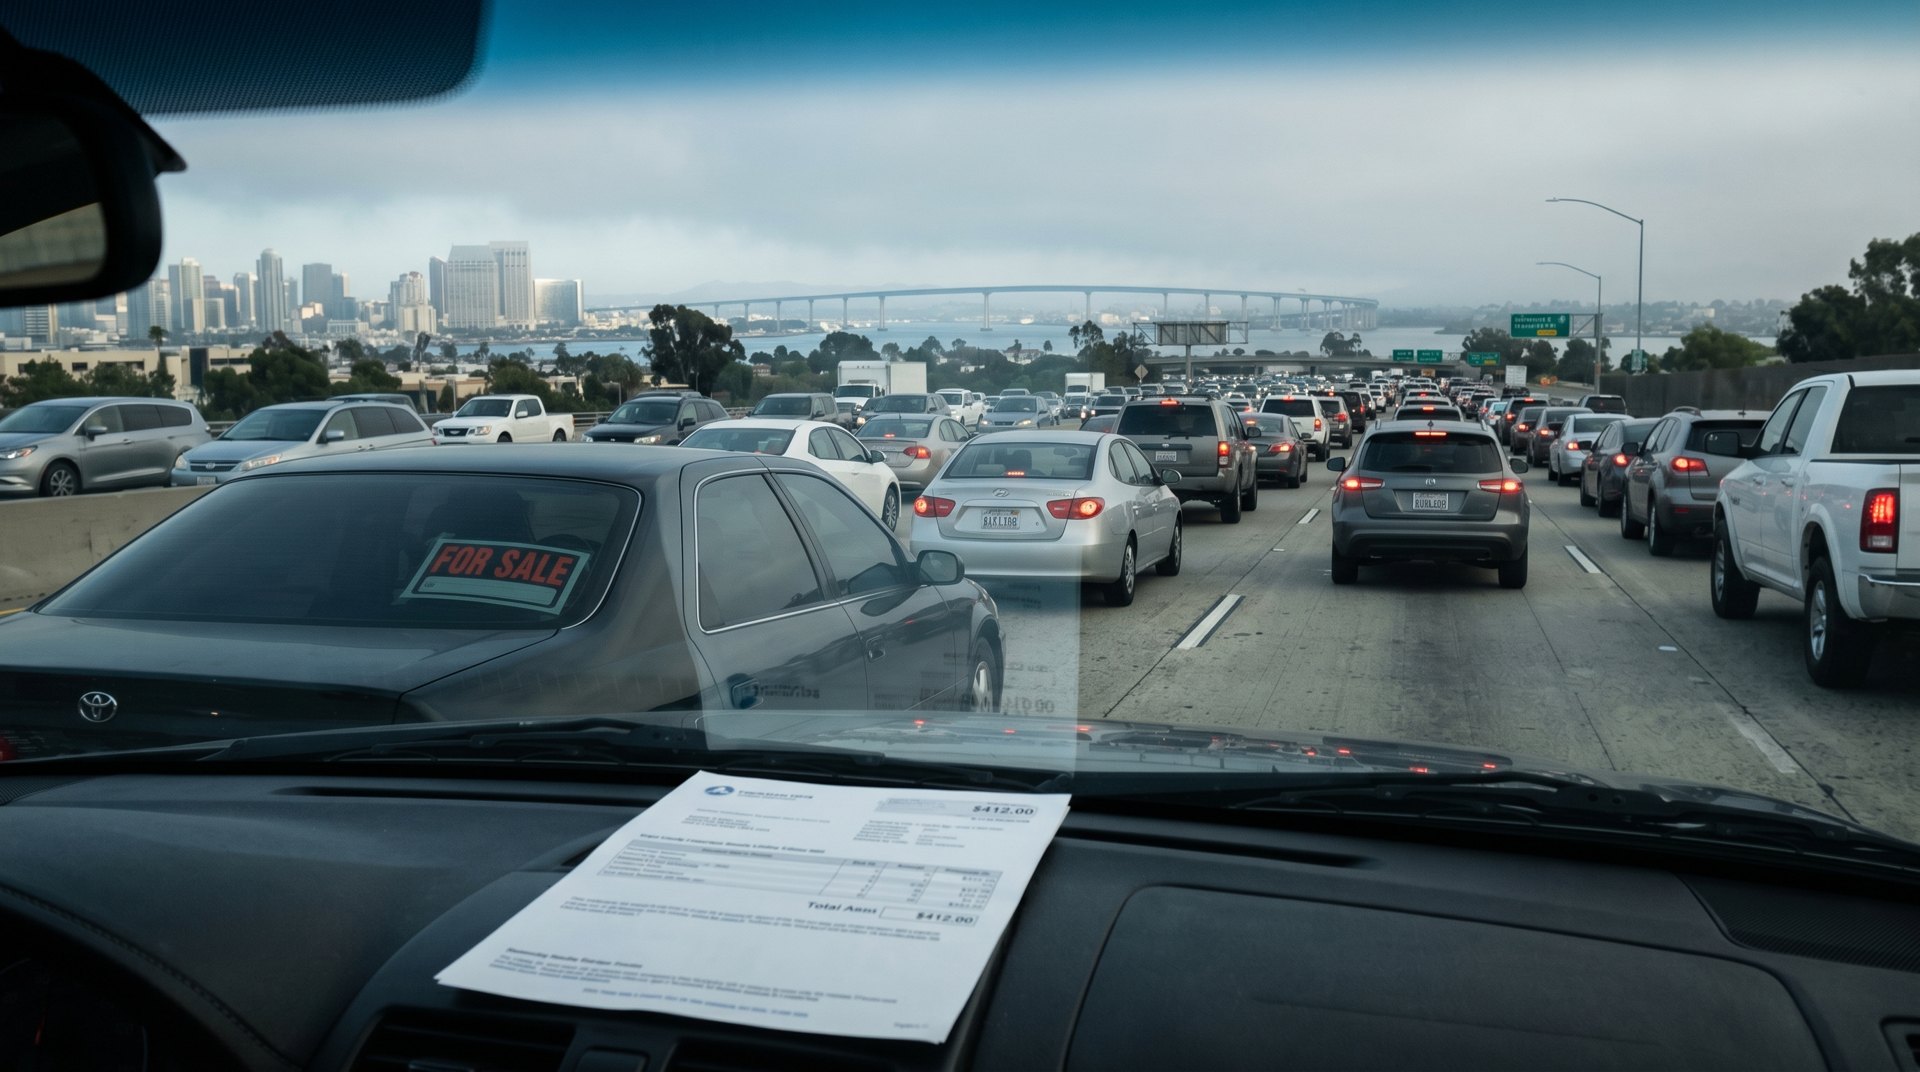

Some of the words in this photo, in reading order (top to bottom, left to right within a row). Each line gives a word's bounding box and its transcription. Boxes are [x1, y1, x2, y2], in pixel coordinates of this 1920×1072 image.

[430, 546, 493, 576] FOR
[494, 550, 573, 587] SALE
[972, 804, 1035, 815] $412.00
[807, 901, 842, 911] Total
[916, 912, 974, 923] $412.00
